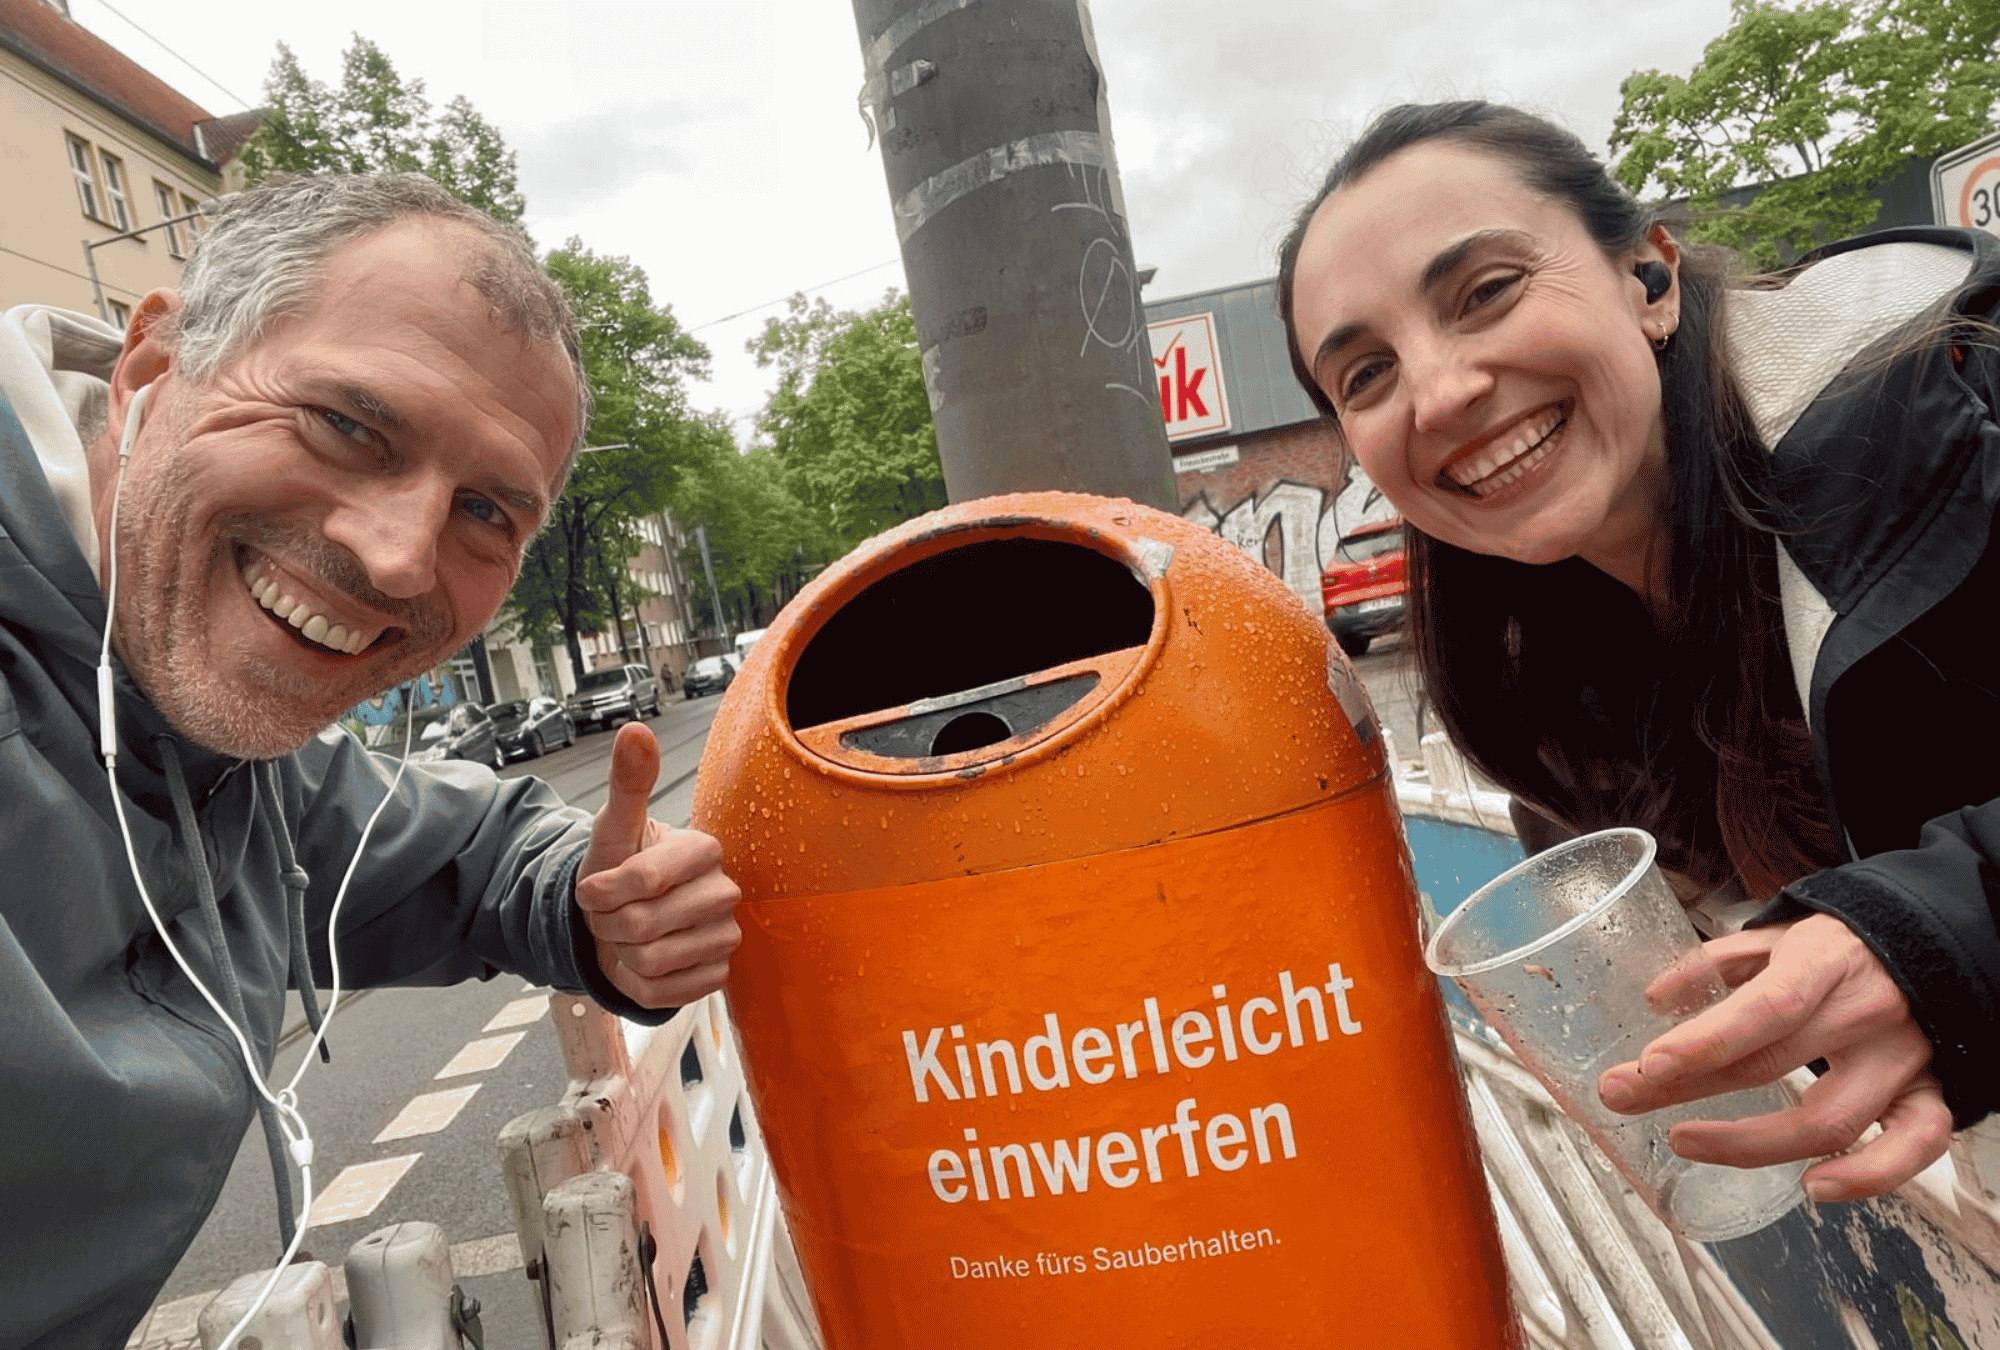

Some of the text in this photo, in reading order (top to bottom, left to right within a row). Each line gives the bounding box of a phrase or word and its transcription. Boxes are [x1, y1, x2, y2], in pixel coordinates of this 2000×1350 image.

[1154, 332, 1210, 423] ik
[902, 962, 1362, 1103] Kinderleicht
[928, 1097, 1297, 1203] einwerfen
[950, 1228, 1282, 1279] Danke fürs Sauberhalten.
